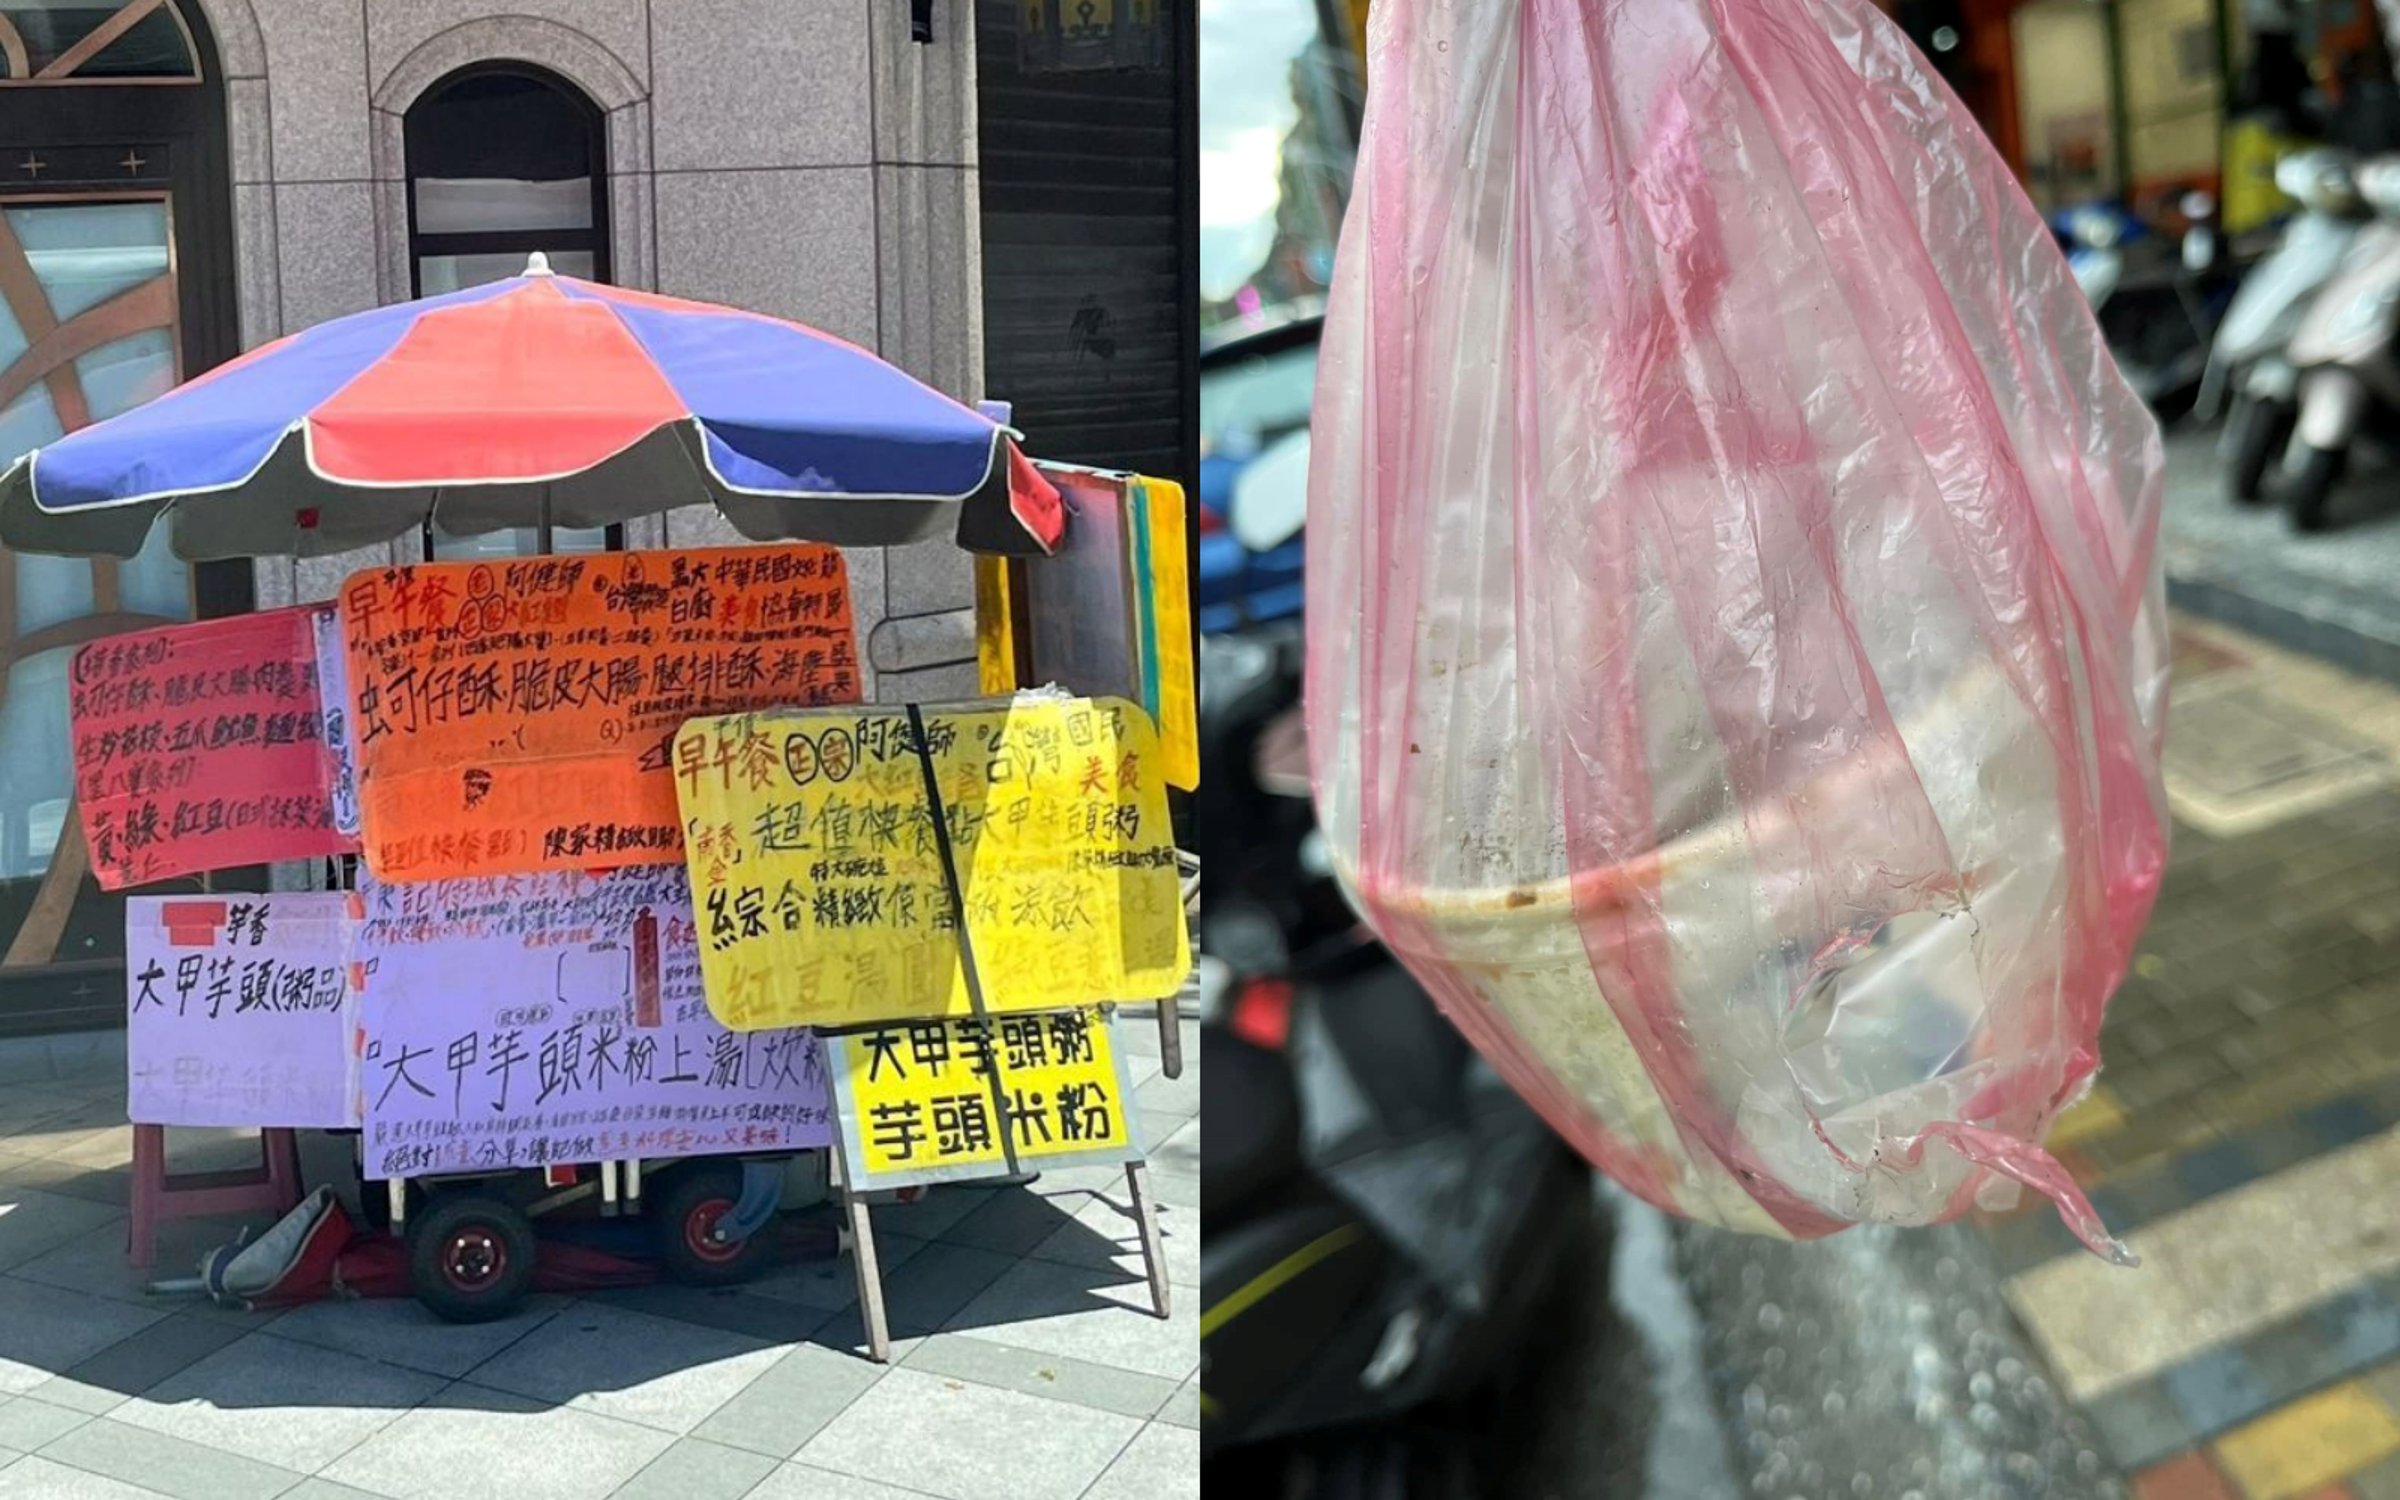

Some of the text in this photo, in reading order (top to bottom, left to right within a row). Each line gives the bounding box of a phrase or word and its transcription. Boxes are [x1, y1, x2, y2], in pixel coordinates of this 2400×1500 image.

[677, 730, 780, 798] 早午餐
[786, 732, 853, 783] 正宗
[855, 716, 957, 763] 阿健師
[1078, 750, 1142, 797] 美食
[228, 902, 271, 946] 芋香
[862, 1010, 1096, 1082] 大甲芋頭粥
[869, 1082, 1111, 1160] 芋頭米粉
